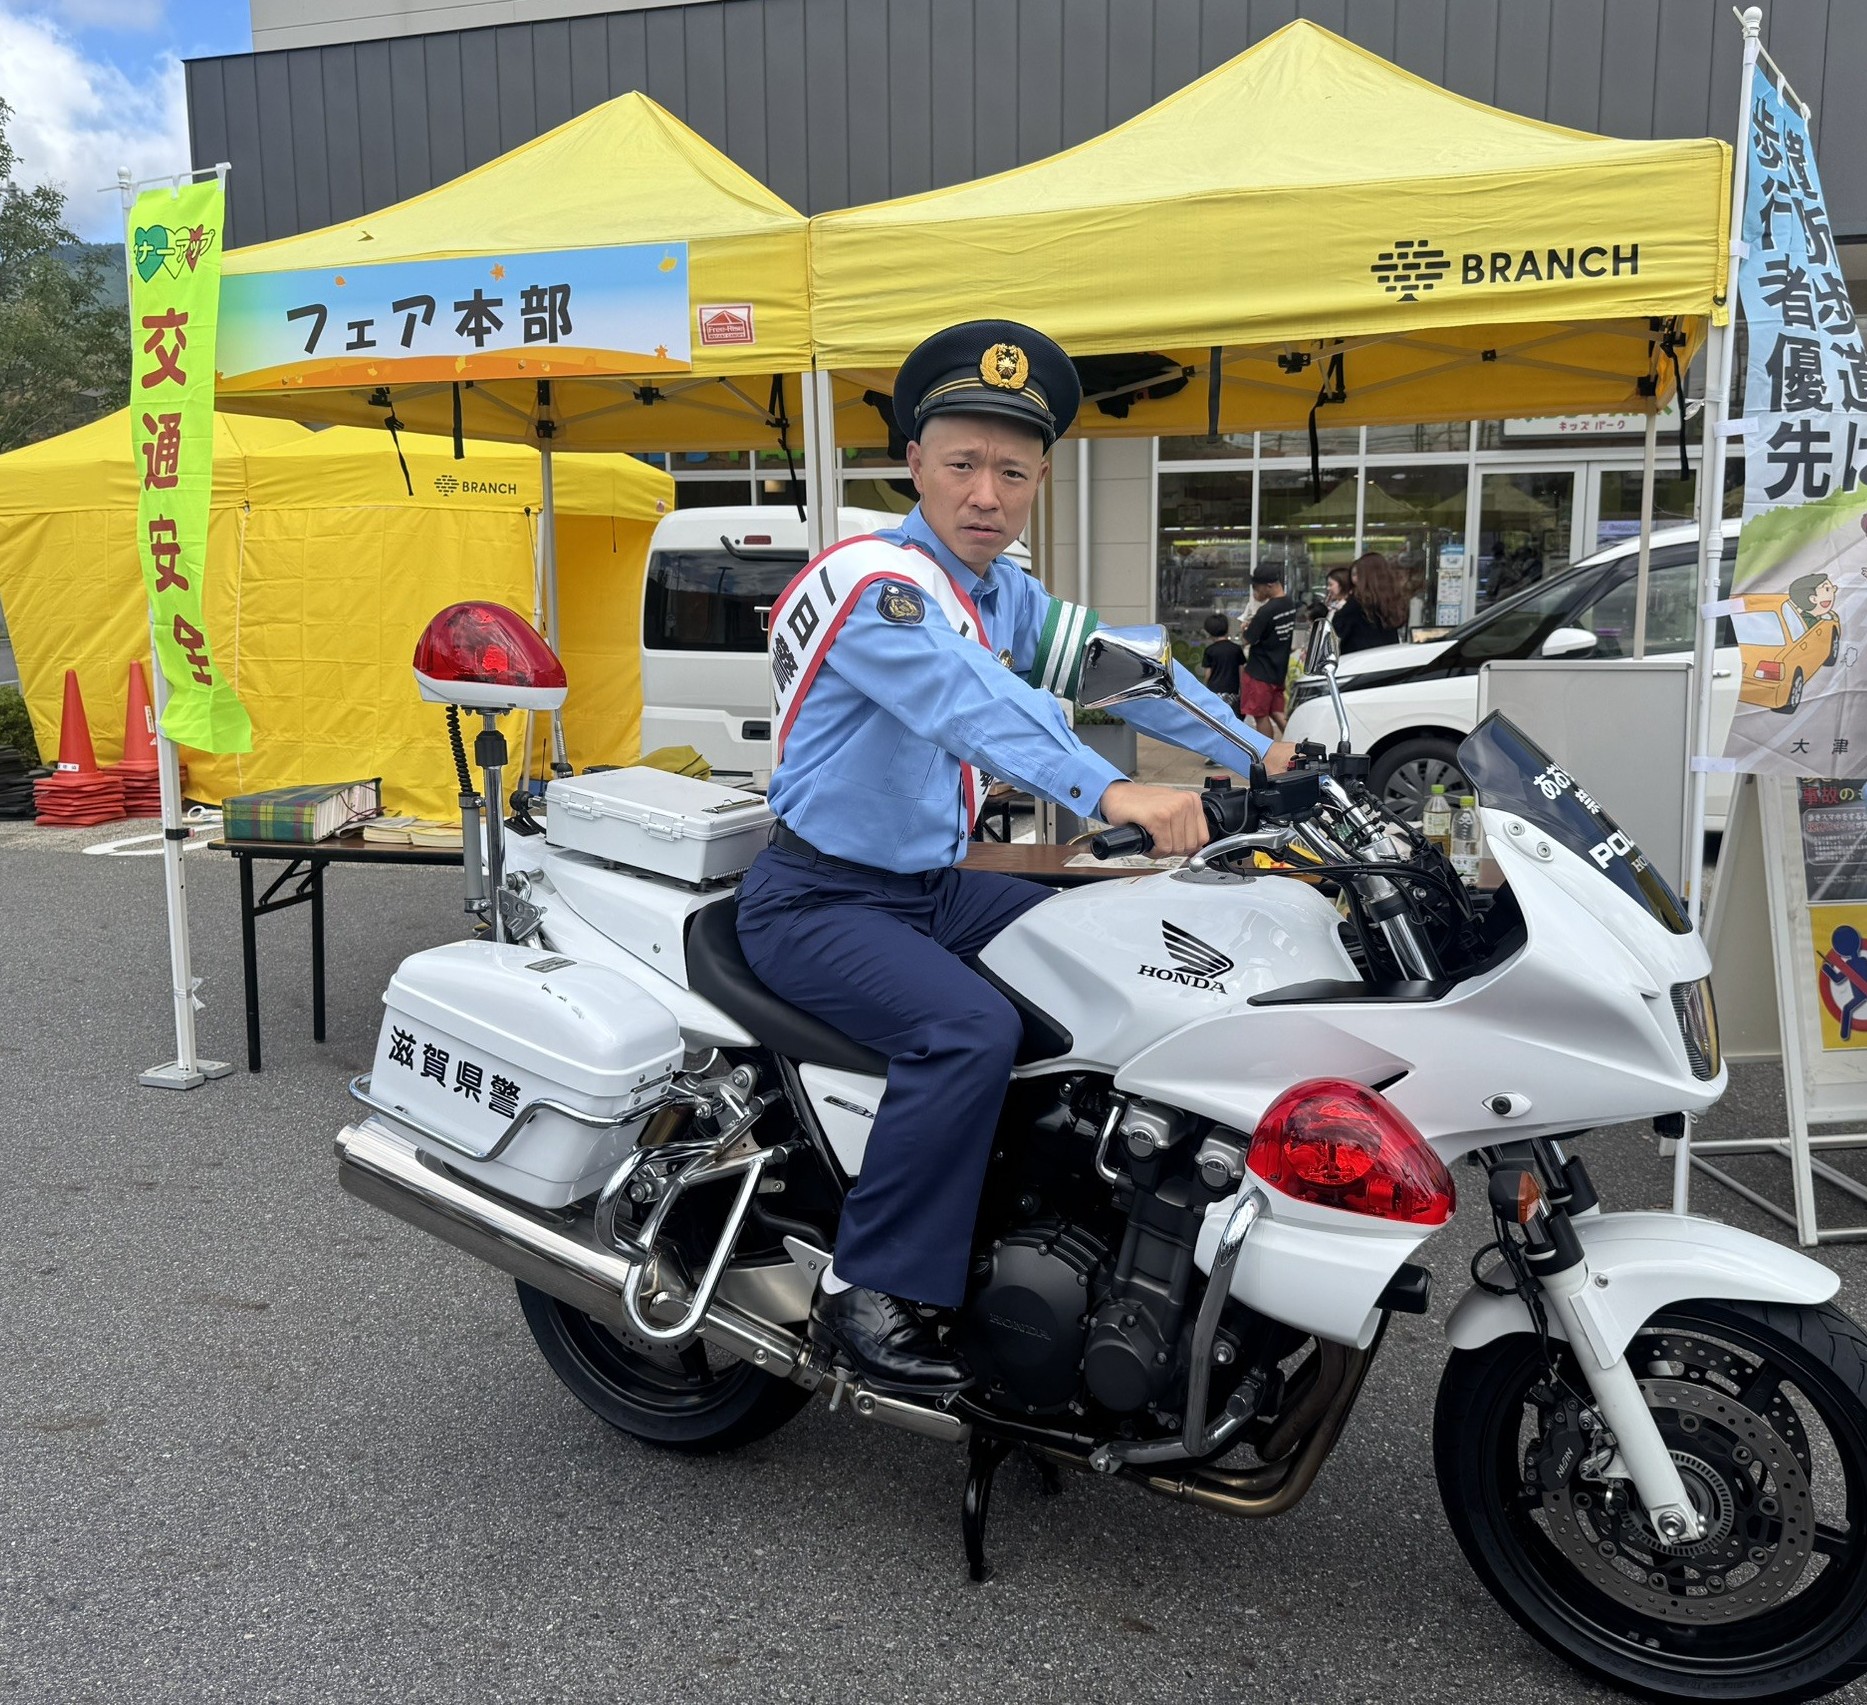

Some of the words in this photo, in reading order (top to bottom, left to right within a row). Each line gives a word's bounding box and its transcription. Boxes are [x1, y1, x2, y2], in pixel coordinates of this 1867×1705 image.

[1461, 243, 1640, 285] BRANCH
[286, 283, 573, 355] フェア本部
[1753, 96, 1834, 500] 歩行者優先
[142, 306, 213, 687] 交通安全
[462, 481, 517, 495] BRANCH
[1790, 738, 1849, 755] 大津
[1533, 761, 1576, 800] あお
[1137, 964, 1228, 995] HONDA
[388, 1025, 521, 1120] 滋賀県警
